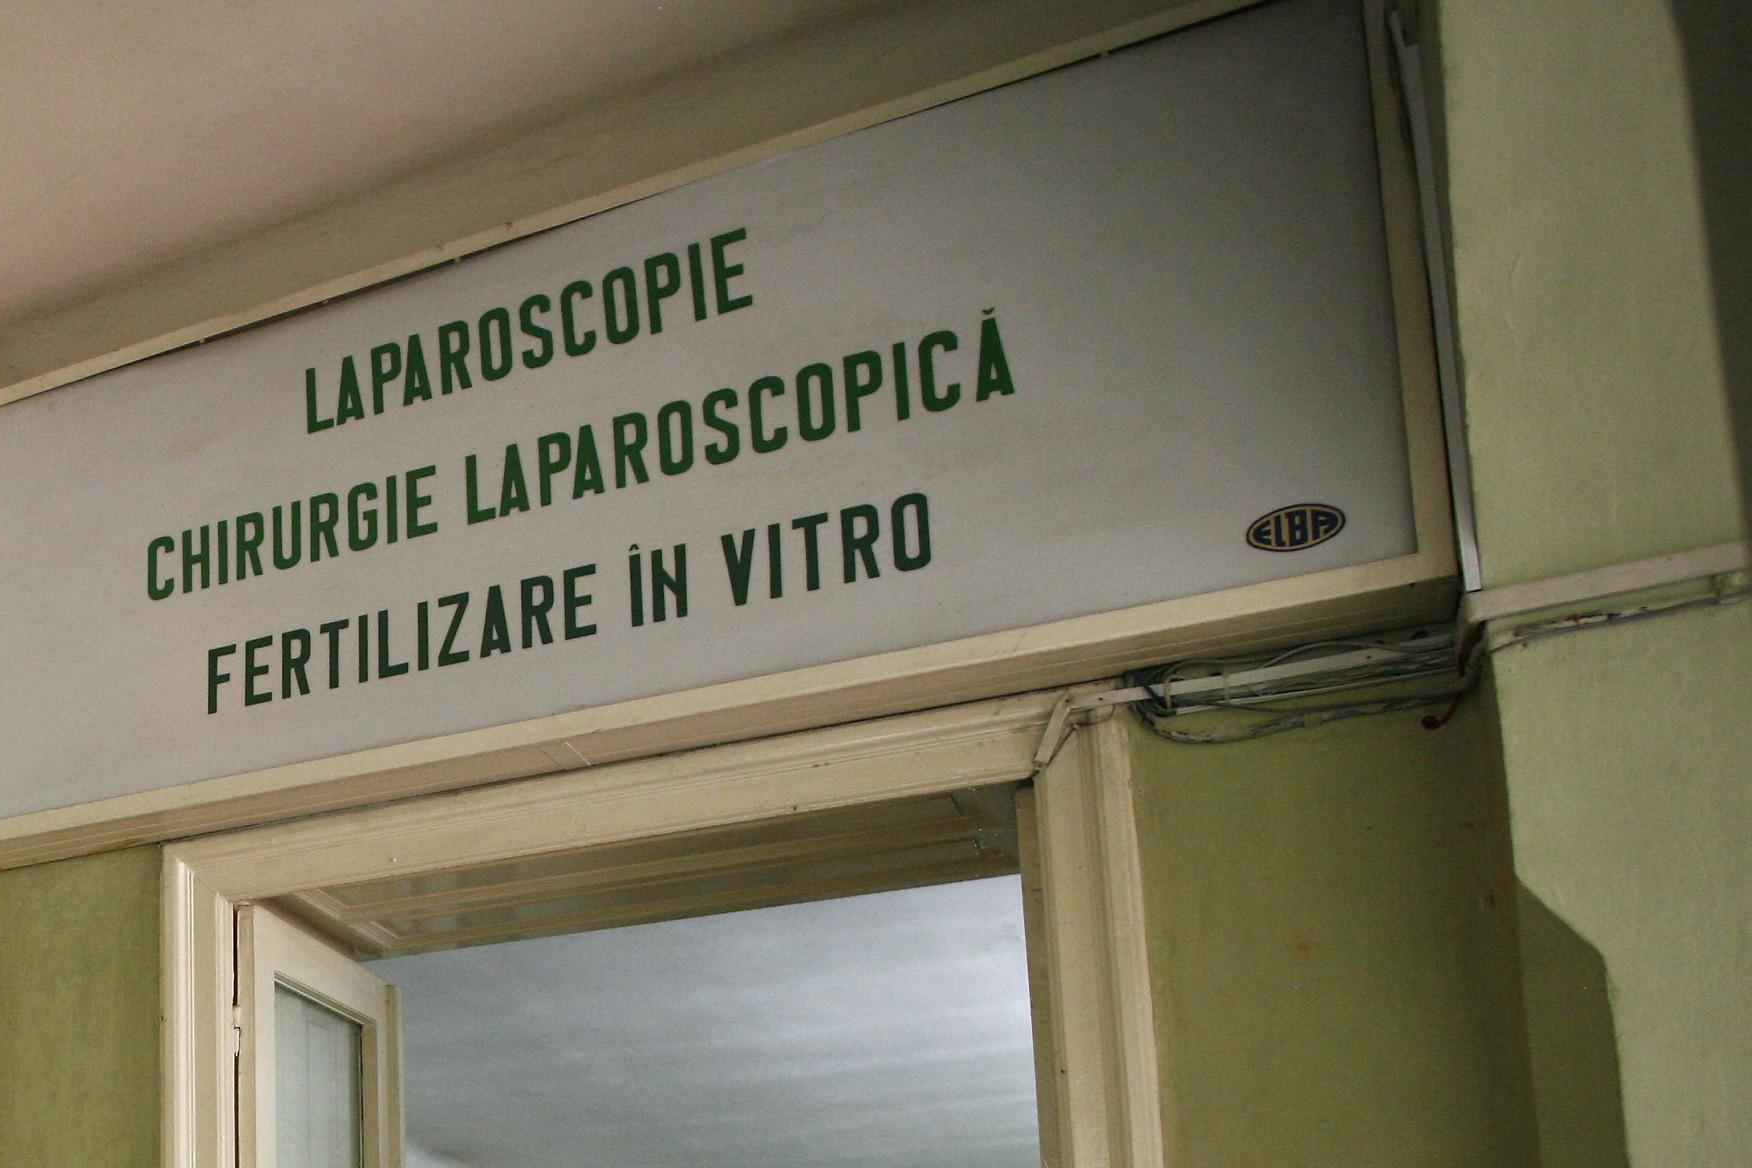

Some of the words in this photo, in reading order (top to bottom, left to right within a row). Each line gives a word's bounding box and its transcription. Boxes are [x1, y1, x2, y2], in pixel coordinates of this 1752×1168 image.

[304, 228, 754, 434] LAPAROSCOPIE
[146, 464, 439, 601] CHIRURGIE
[464, 307, 1016, 525] LAPAROSCOPICĂ
[1251, 508, 1339, 547] ELBA
[206, 563, 598, 715] FERTILIZARE
[628, 542, 688, 628] ÎN
[721, 492, 934, 607] VITRO
